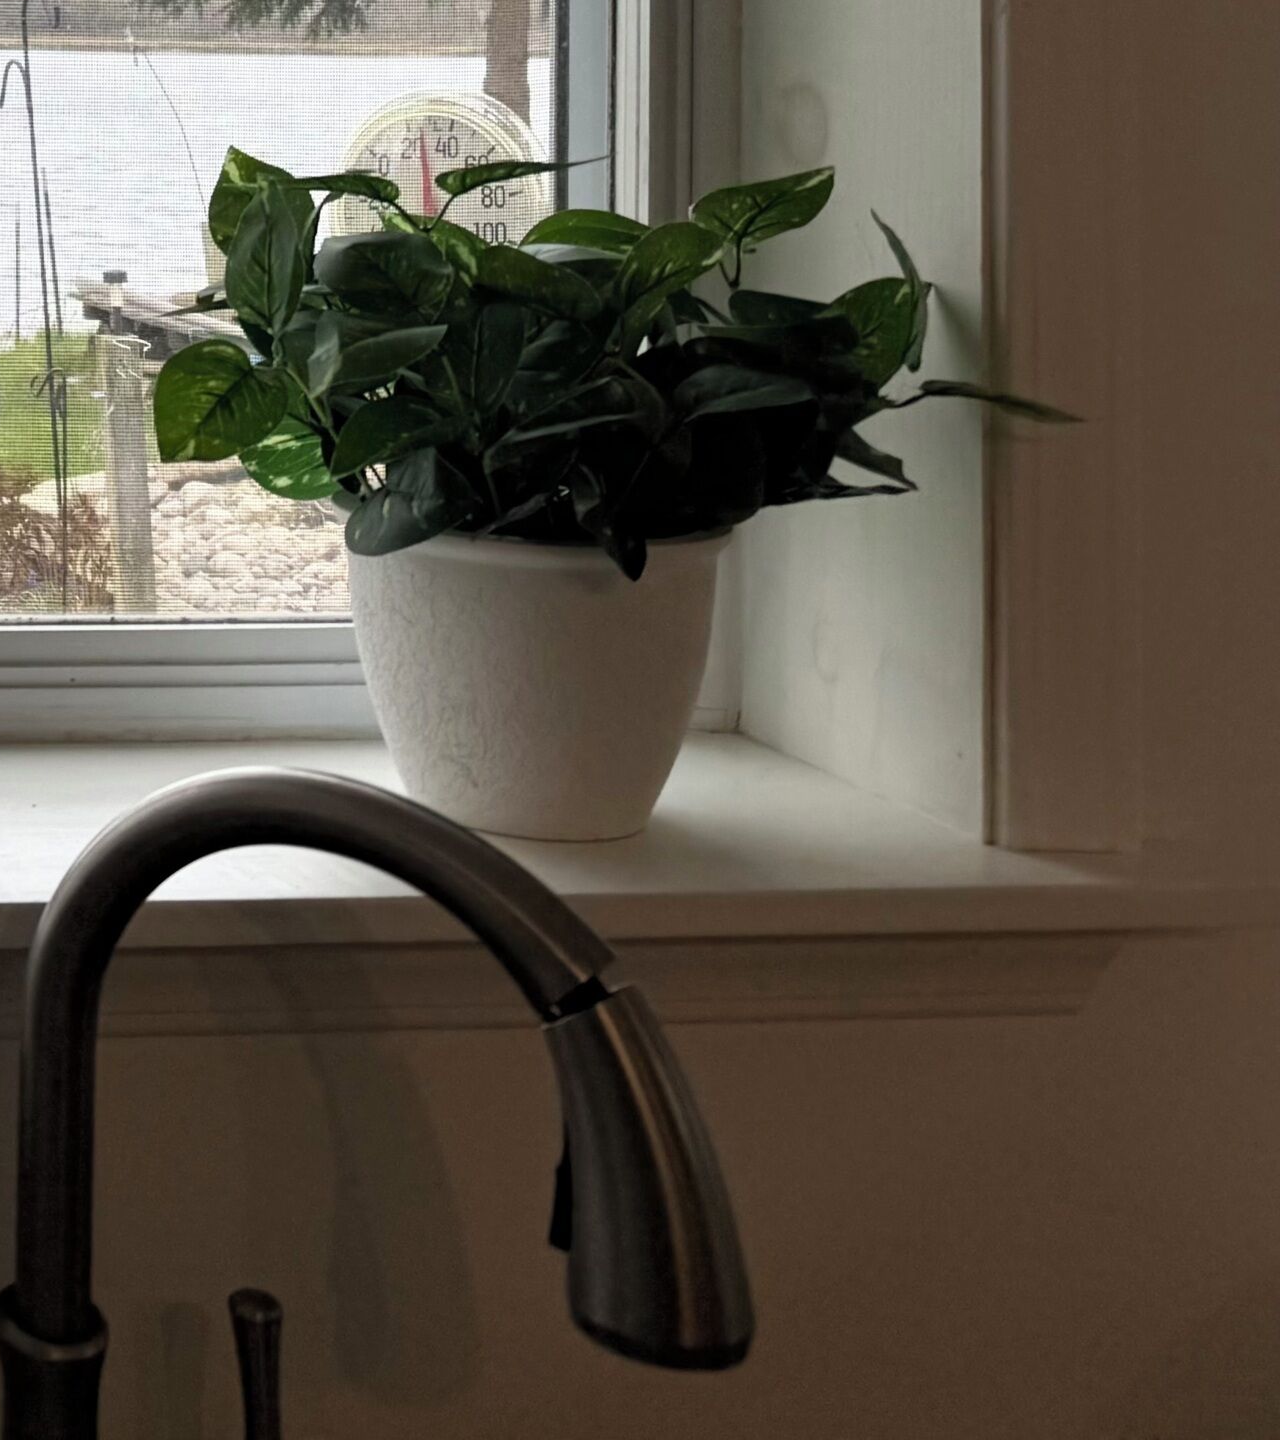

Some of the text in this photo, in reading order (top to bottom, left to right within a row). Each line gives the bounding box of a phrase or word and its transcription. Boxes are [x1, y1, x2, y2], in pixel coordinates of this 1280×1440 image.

[435, 136, 459, 158] 40
[481, 185, 506, 208] 80
[473, 222, 507, 245] 100
